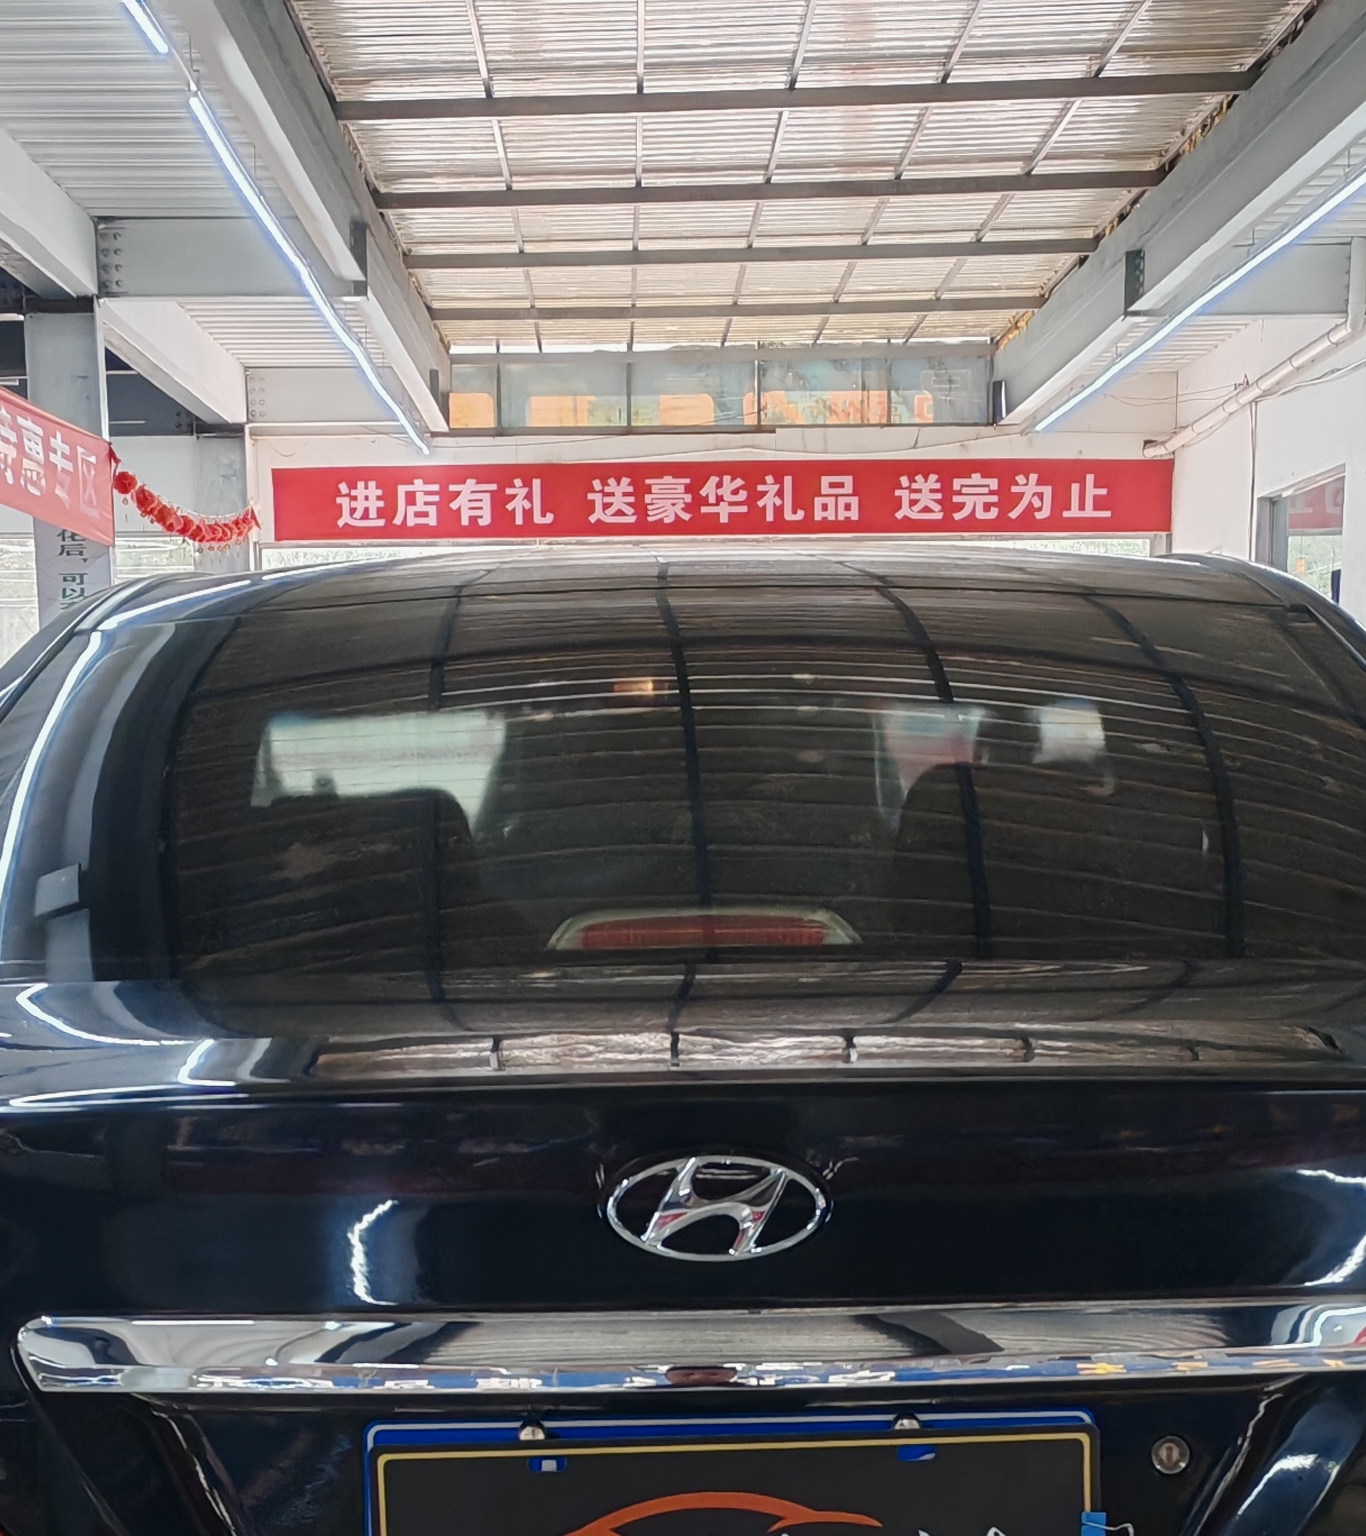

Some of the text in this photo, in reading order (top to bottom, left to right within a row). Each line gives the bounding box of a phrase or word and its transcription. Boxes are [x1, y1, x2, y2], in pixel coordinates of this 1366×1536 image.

[336, 471, 1113, 529] 进店有礼 送豪华礼品 送完为止
